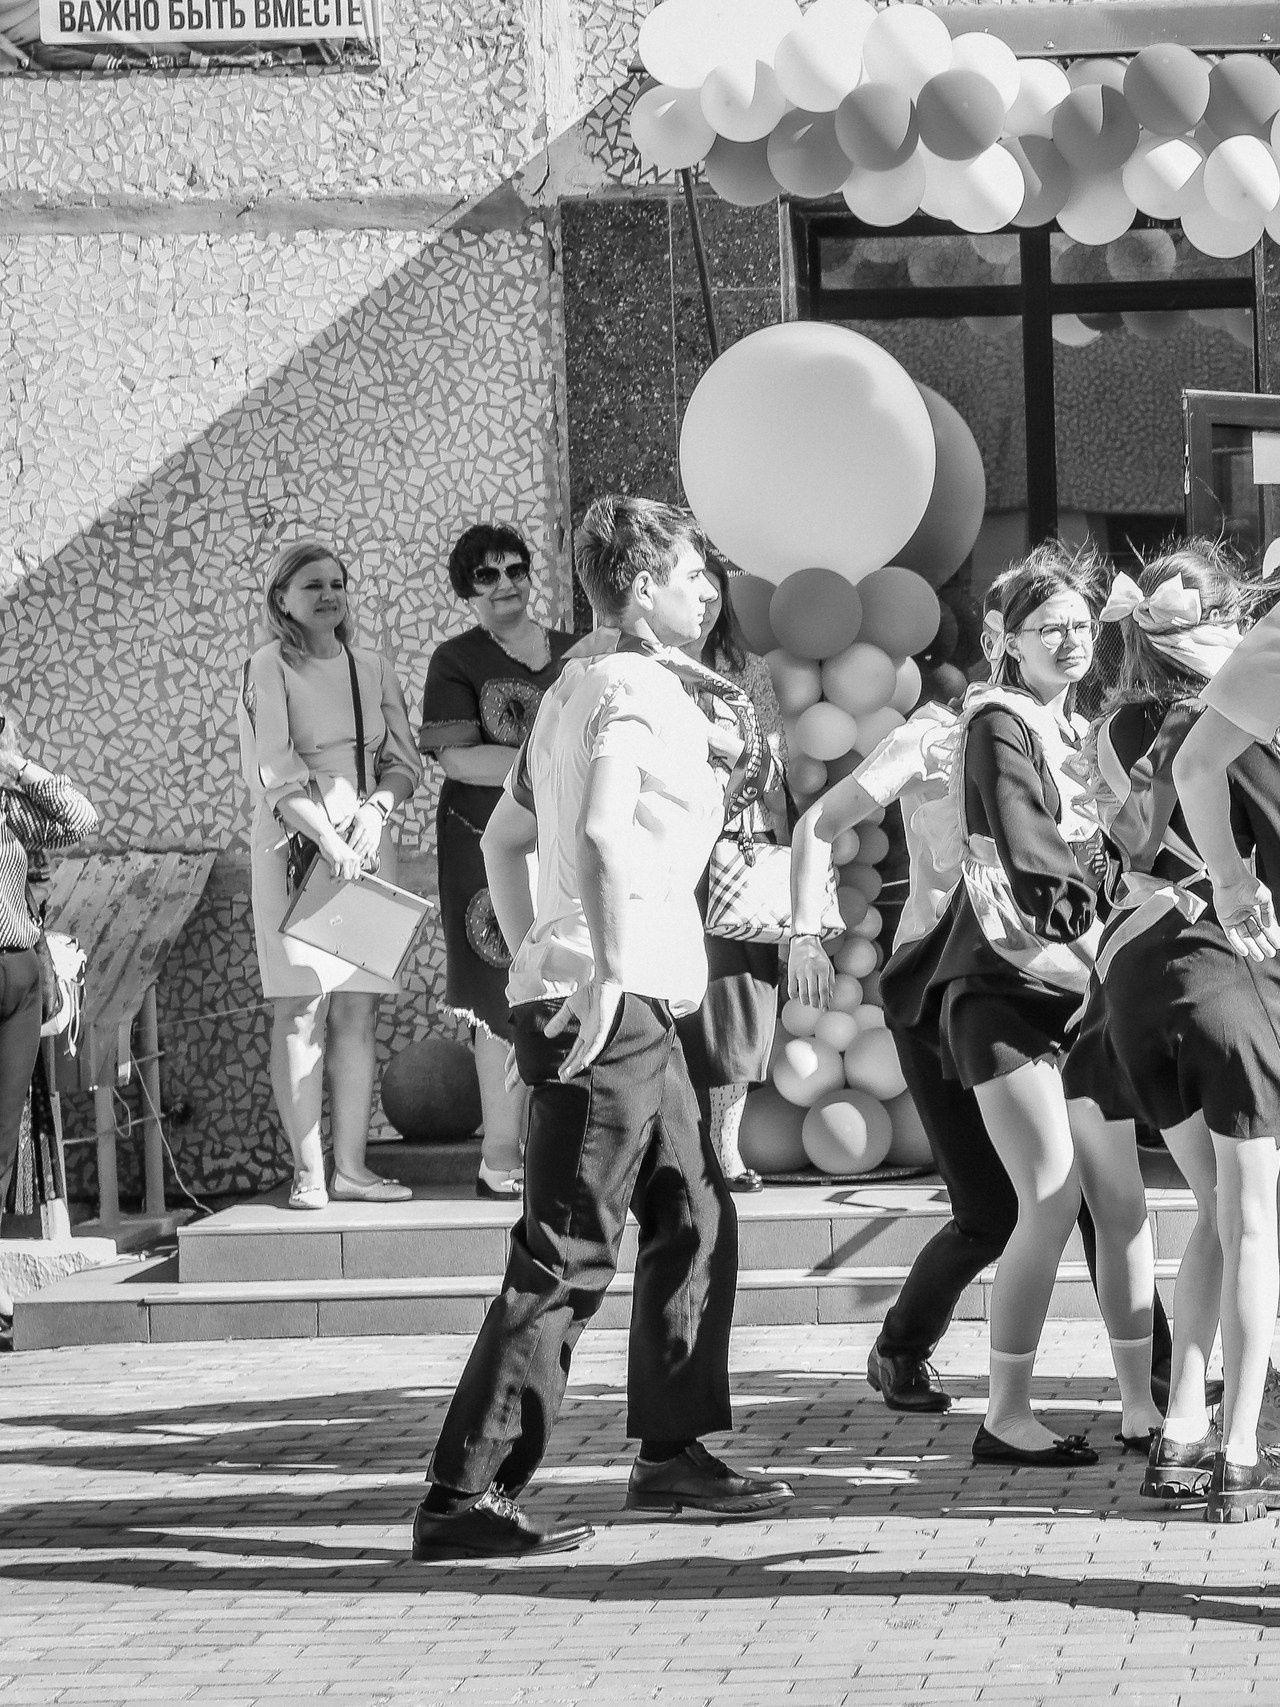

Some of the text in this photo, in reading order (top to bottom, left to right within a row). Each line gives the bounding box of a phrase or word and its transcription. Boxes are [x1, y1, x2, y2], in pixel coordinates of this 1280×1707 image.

[59, 0, 363, 33] ВАЖНО БЫТЬ ВМЕСТЕ
